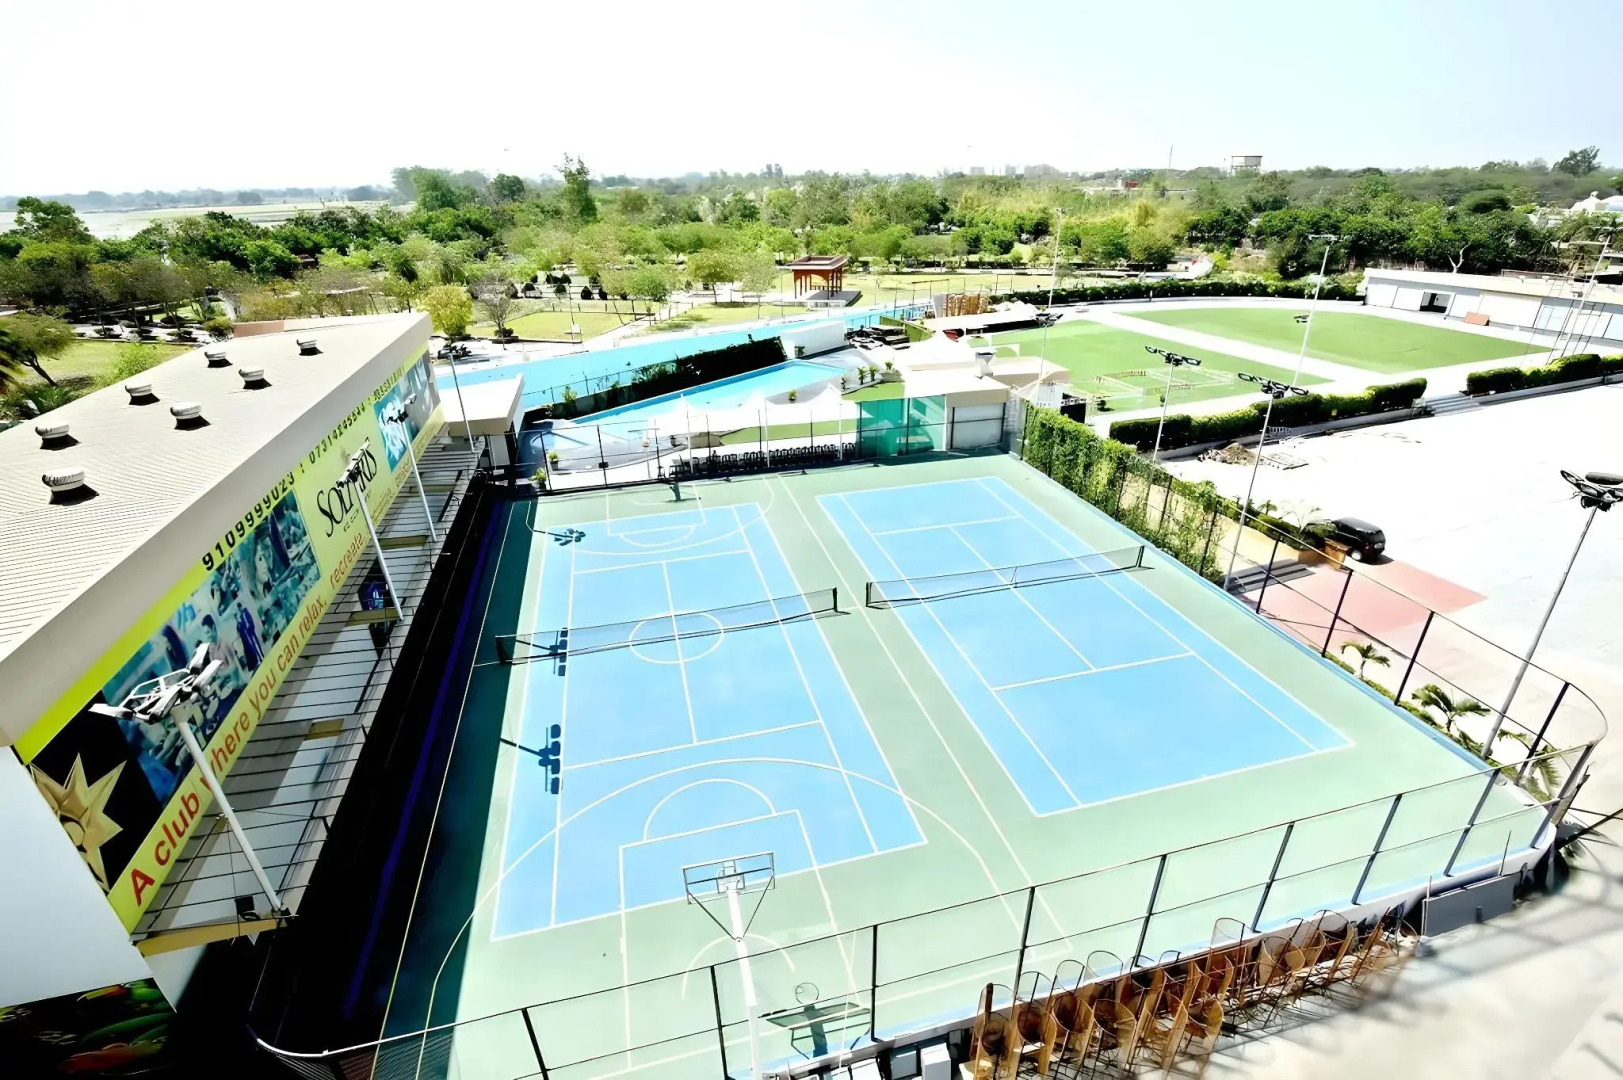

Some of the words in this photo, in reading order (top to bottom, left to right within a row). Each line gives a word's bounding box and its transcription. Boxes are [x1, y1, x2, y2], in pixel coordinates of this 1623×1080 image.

[131, 868, 155, 907] A
[155, 792, 200, 866] club
[250, 670, 276, 721] you
[277, 634, 299, 673] can
